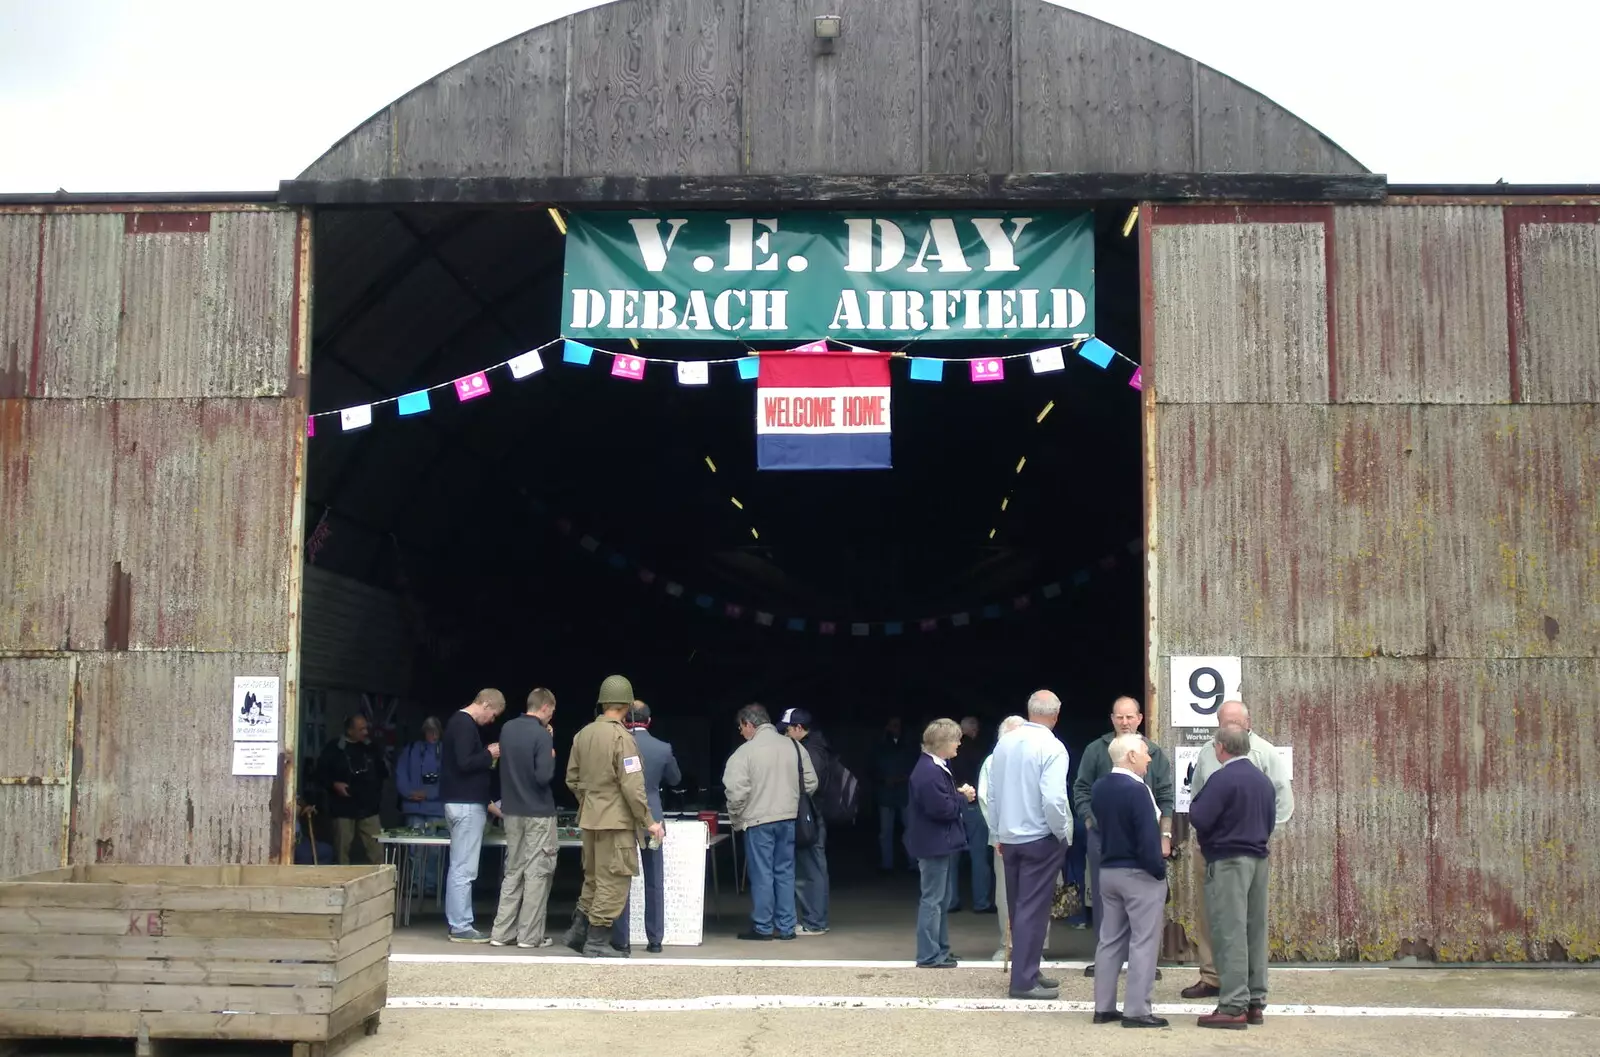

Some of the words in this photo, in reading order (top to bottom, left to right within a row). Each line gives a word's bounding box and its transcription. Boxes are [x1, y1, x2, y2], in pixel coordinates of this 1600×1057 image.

[628, 218, 808, 272] V.E.
[843, 217, 1033, 273] DAY
[570, 289, 788, 331] DEBACH
[828, 288, 1086, 331] AIRFIELD
[764, 396, 836, 427] WELCOME
[842, 396, 885, 427] HOME
[1189, 667, 1225, 715] 9
[1186, 733, 1215, 741] Worksho
